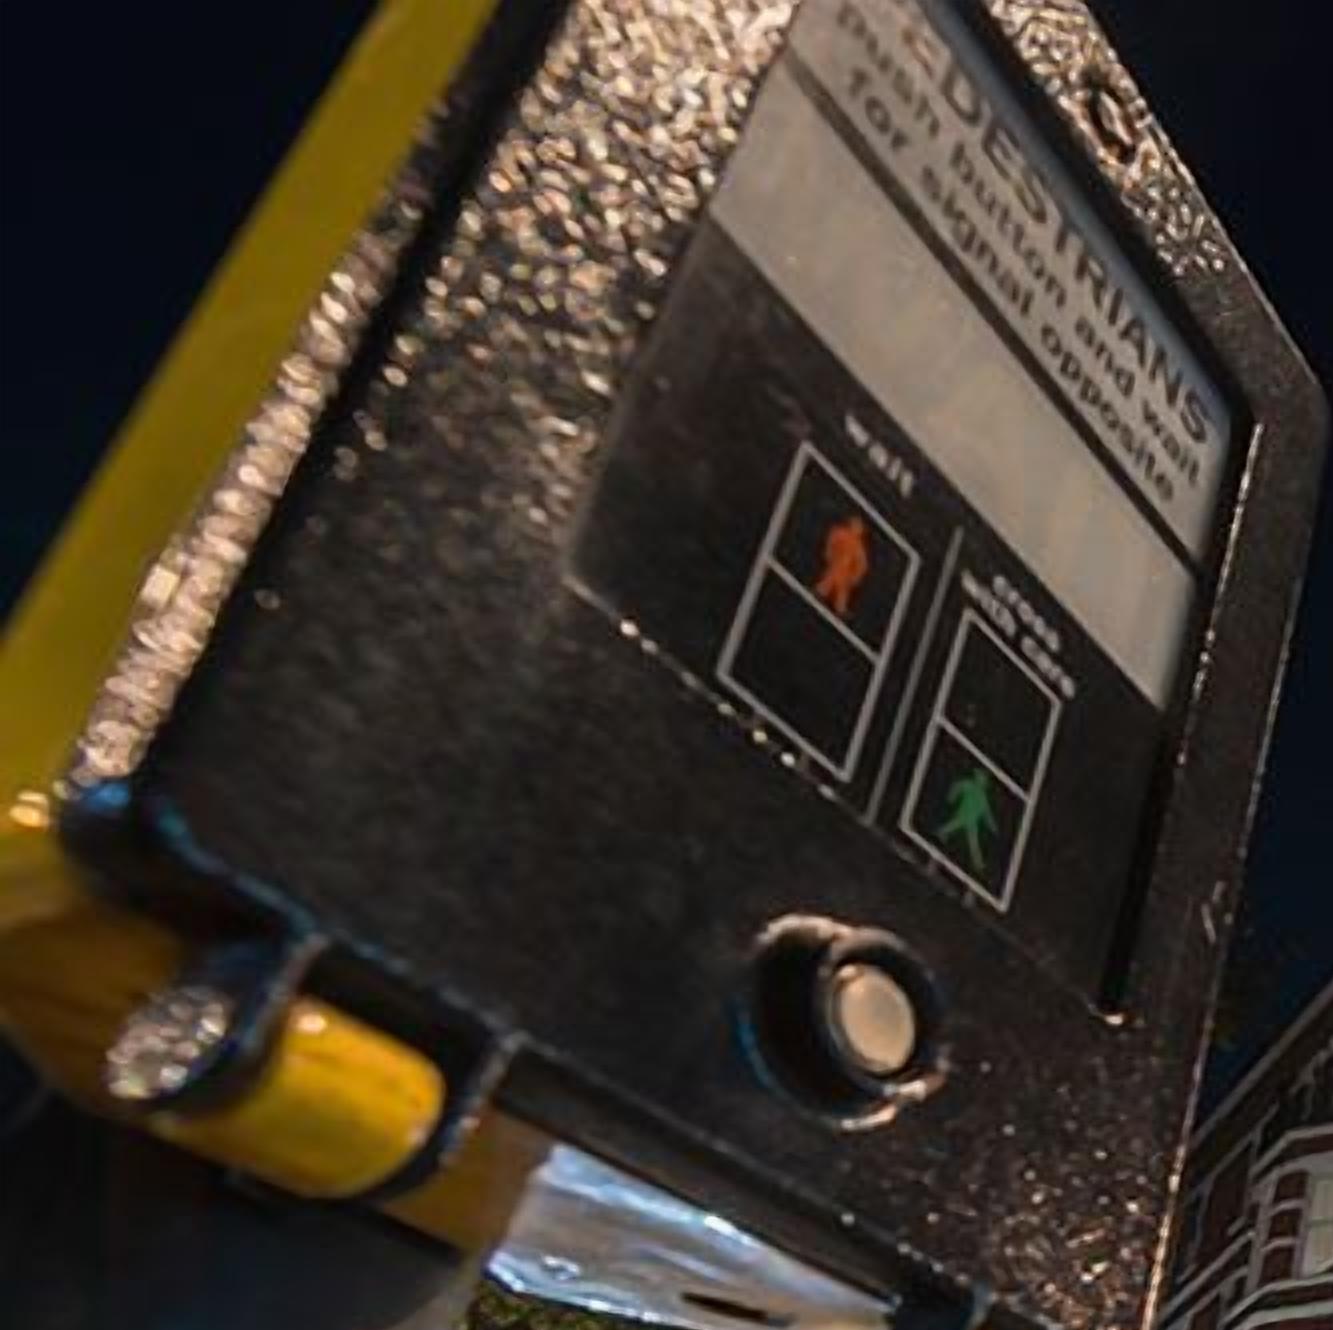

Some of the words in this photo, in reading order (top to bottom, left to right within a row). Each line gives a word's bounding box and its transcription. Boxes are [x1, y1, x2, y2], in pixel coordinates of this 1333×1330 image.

[848, 66, 909, 152] for
[919, 164, 1034, 317] signal
[1040, 325, 1175, 502] opposite
[900, 10, 1208, 444] EDESTRIANS
[950, 138, 1067, 309] button
[1075, 315, 1137, 398] and
[1140, 398, 1200, 488] wait
